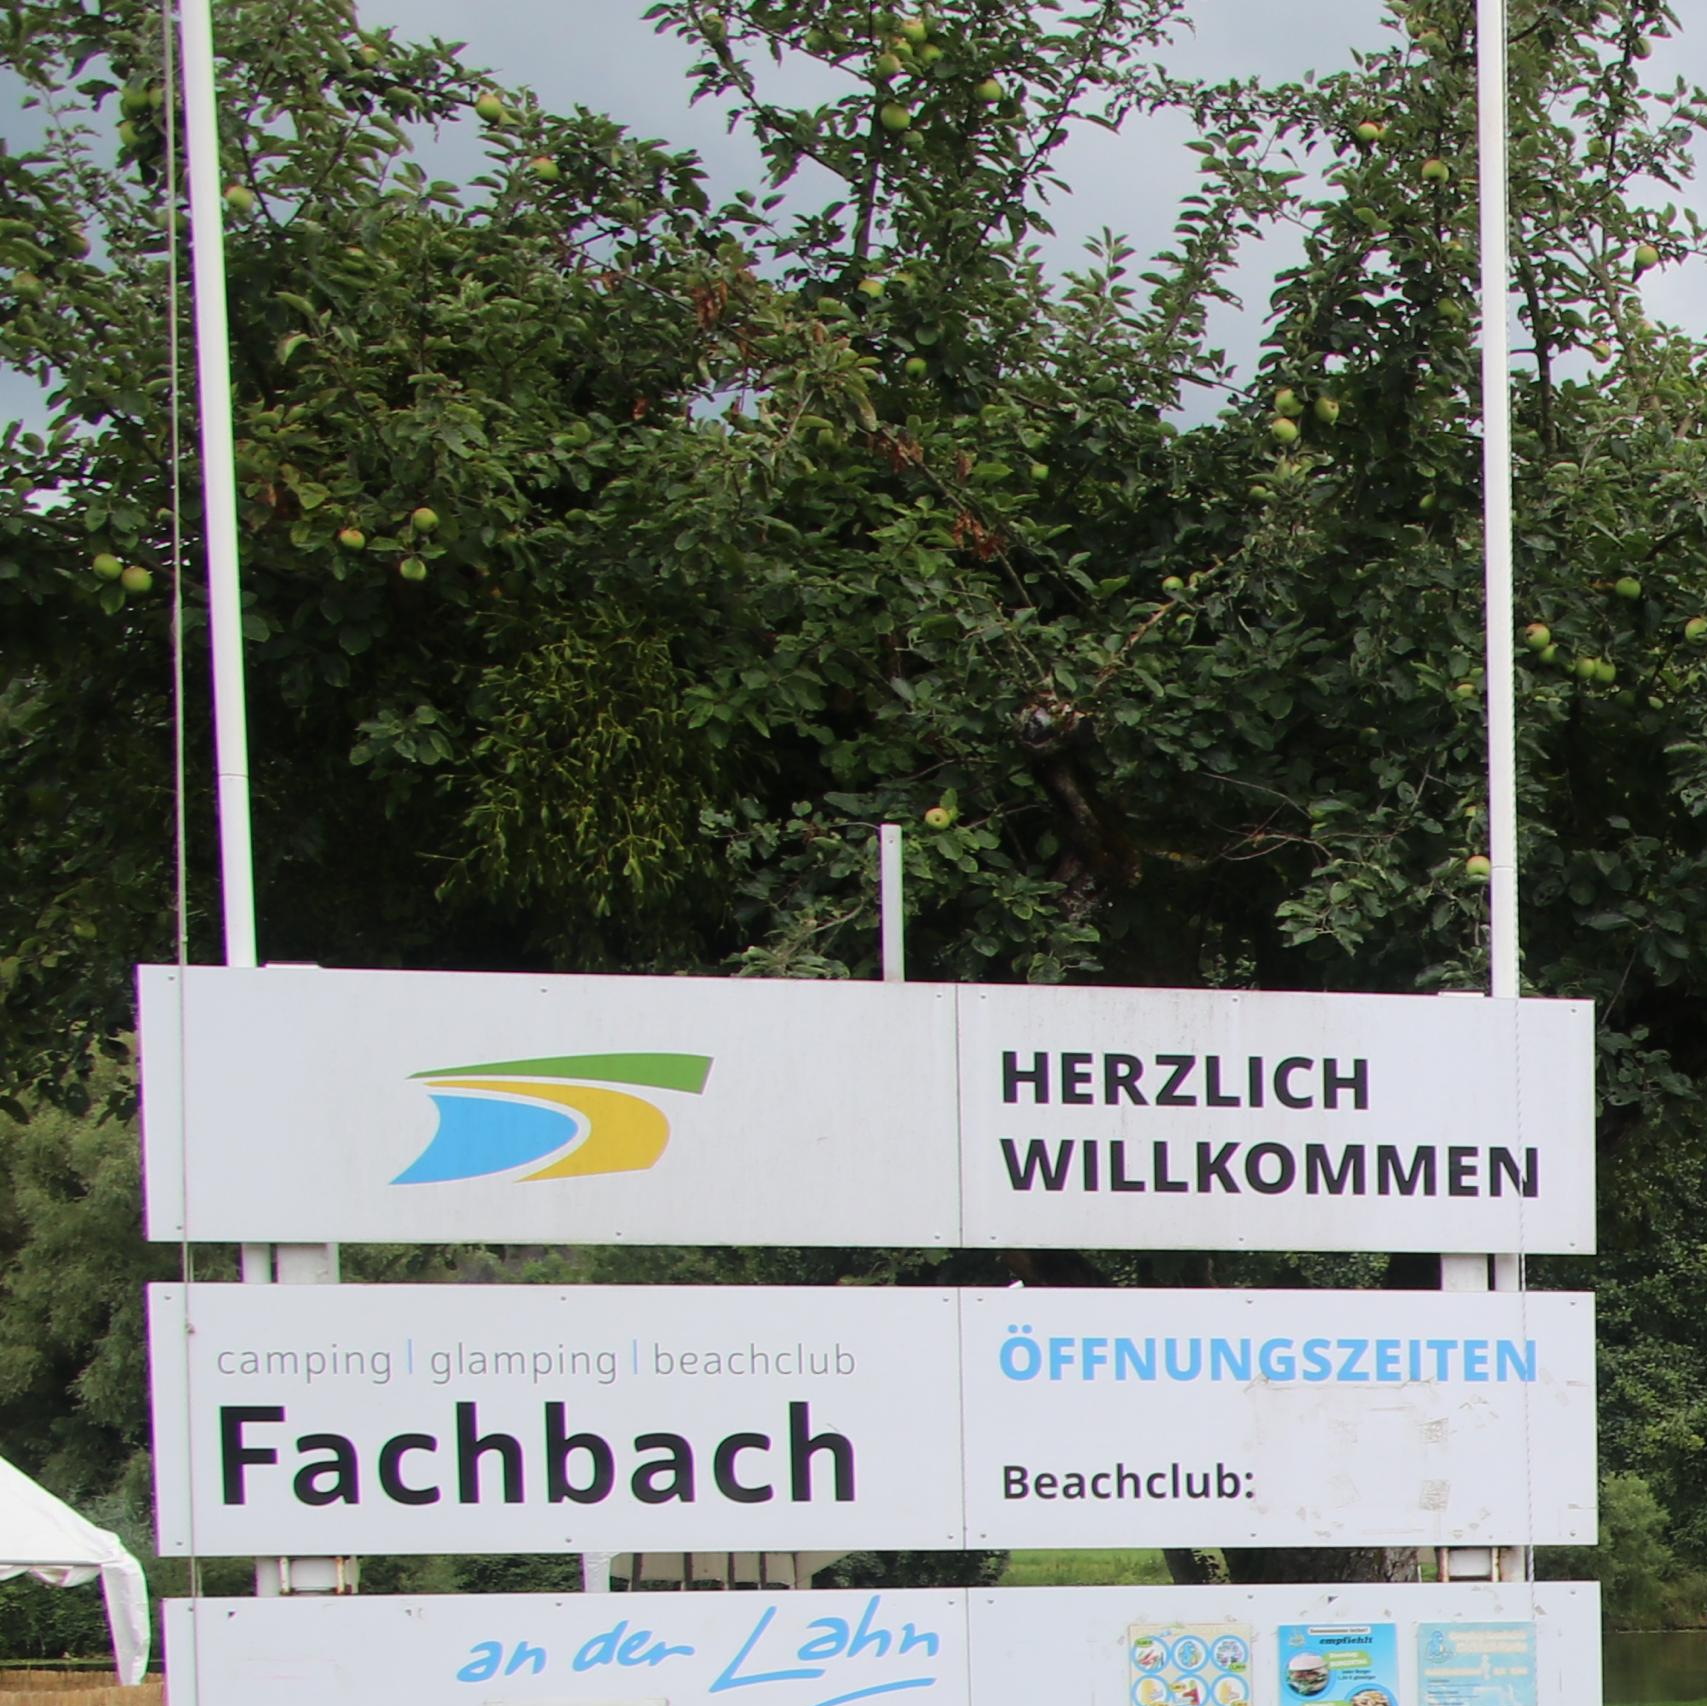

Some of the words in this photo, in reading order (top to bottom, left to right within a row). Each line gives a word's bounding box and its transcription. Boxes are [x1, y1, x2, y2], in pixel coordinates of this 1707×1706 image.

[1001, 1051, 1370, 1111] HERZLICH
[1000, 1137, 1540, 1198] WILLKOMMEN
[217, 1343, 391, 1382] camping
[430, 1341, 617, 1383] glamping
[653, 1342, 857, 1376] beachclub
[1000, 1324, 1537, 1382] ÖFFNUNGSZEITEN
[219, 1400, 856, 1505] Fachbach
[1002, 1463, 1254, 1499] Beachclub:
[457, 1640, 547, 1683] an
[572, 1619, 695, 1672] der
[709, 1594, 940, 1693] Lahn
